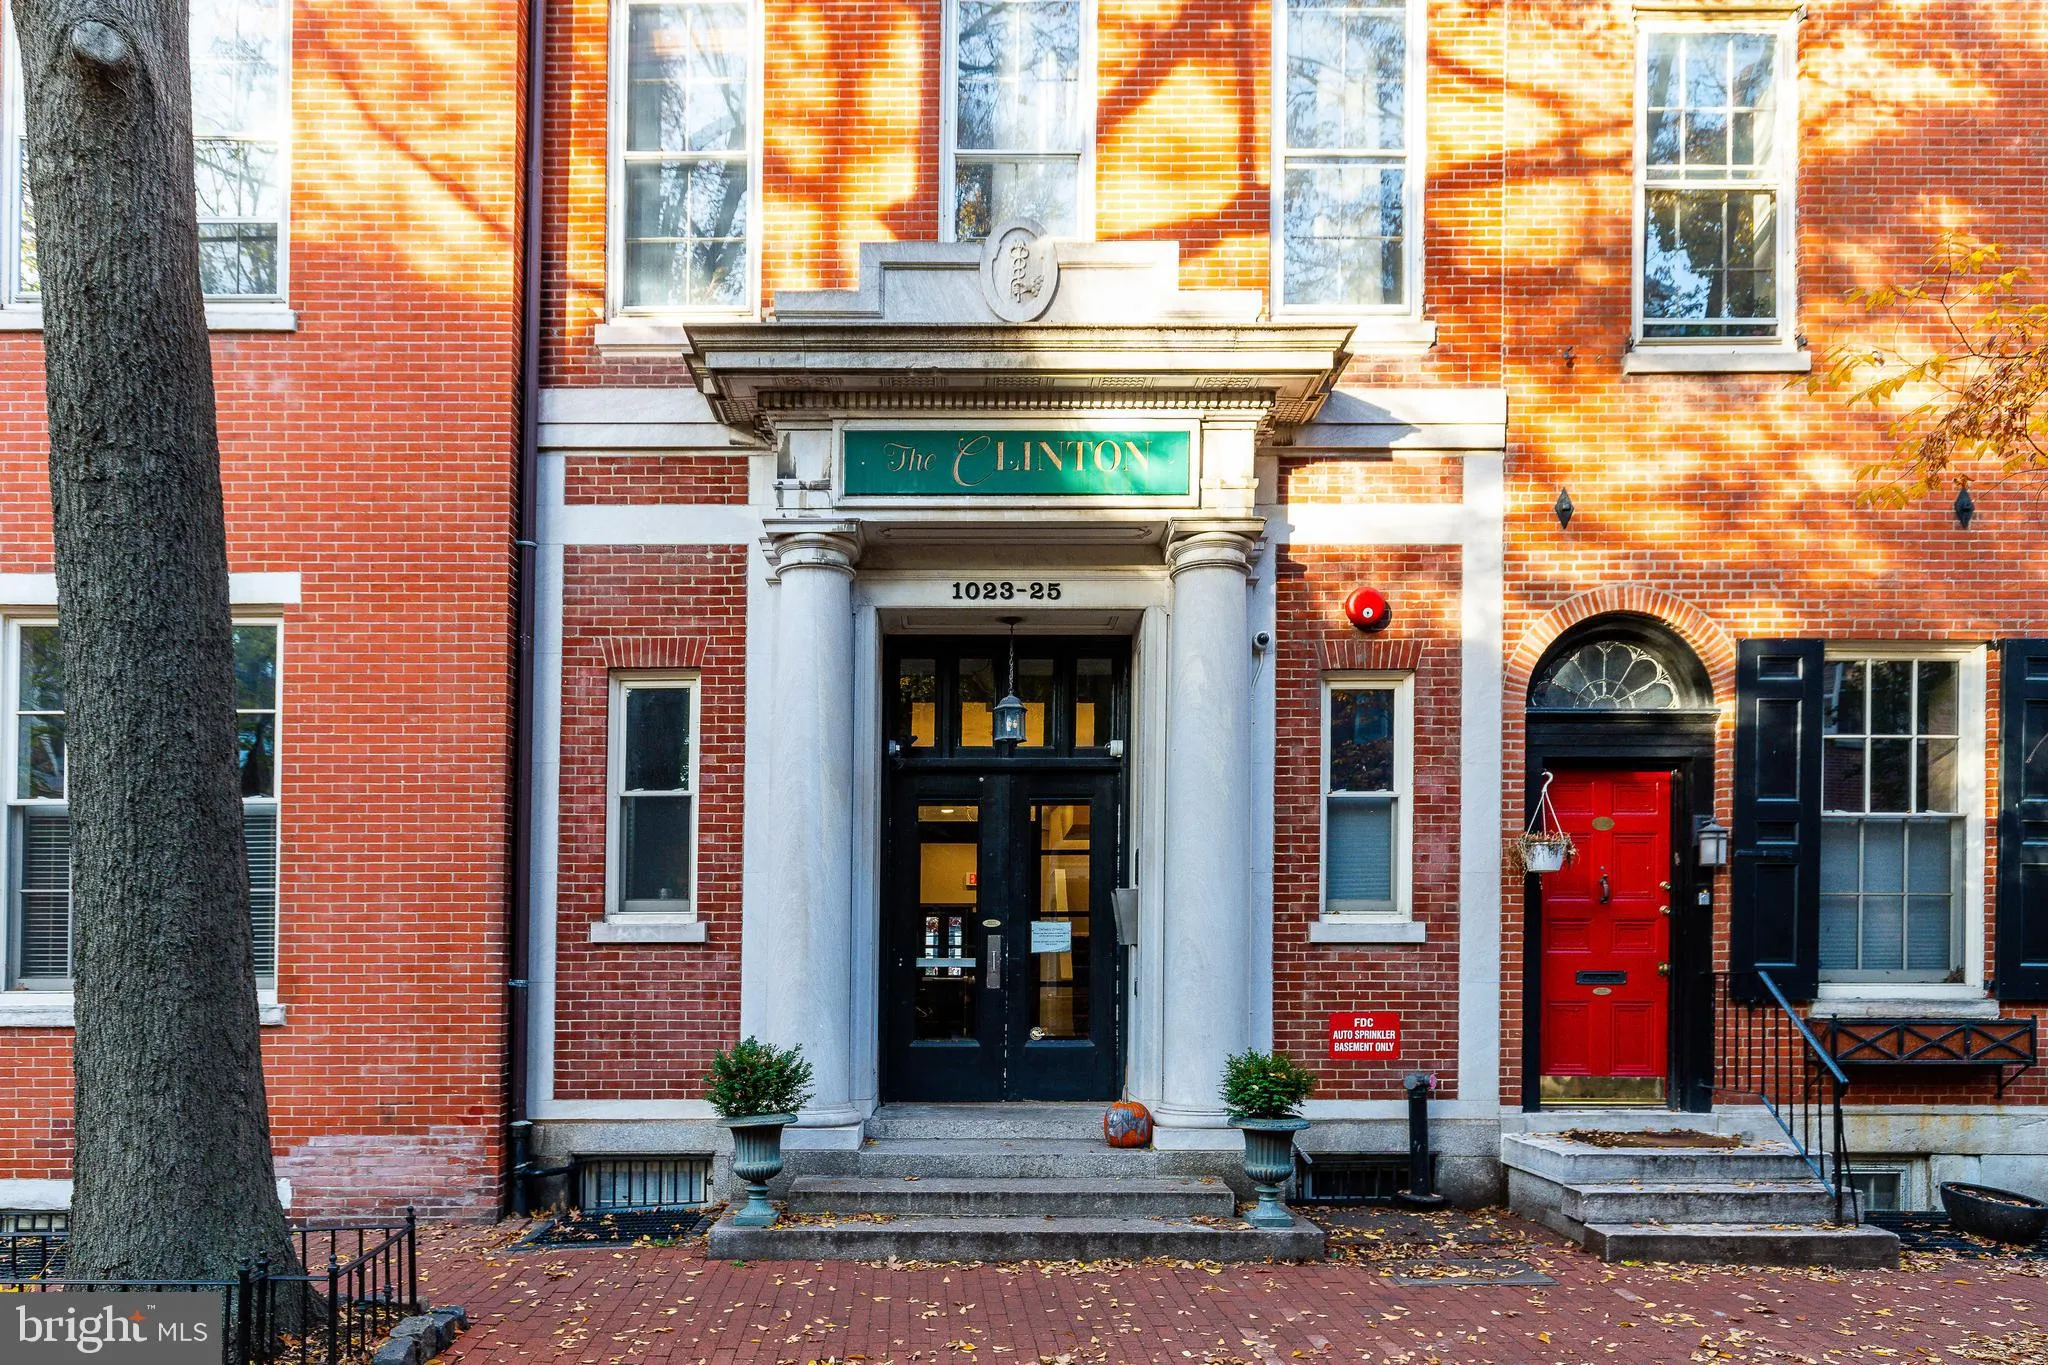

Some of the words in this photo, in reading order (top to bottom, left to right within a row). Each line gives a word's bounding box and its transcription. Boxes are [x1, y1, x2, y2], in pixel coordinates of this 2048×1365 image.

[883, 442, 937, 472] The
[953, 435, 1152, 487] CLINTON
[952, 582, 1061, 600] 1023-25
[1354, 1018, 1374, 1027] FDC
[1333, 1030, 1353, 1039] AUTO
[1354, 1030, 1396, 1039] SPRINKLER
[1334, 1042, 1374, 1051] BASEMENT
[1375, 1042, 1394, 1051] ONLY
